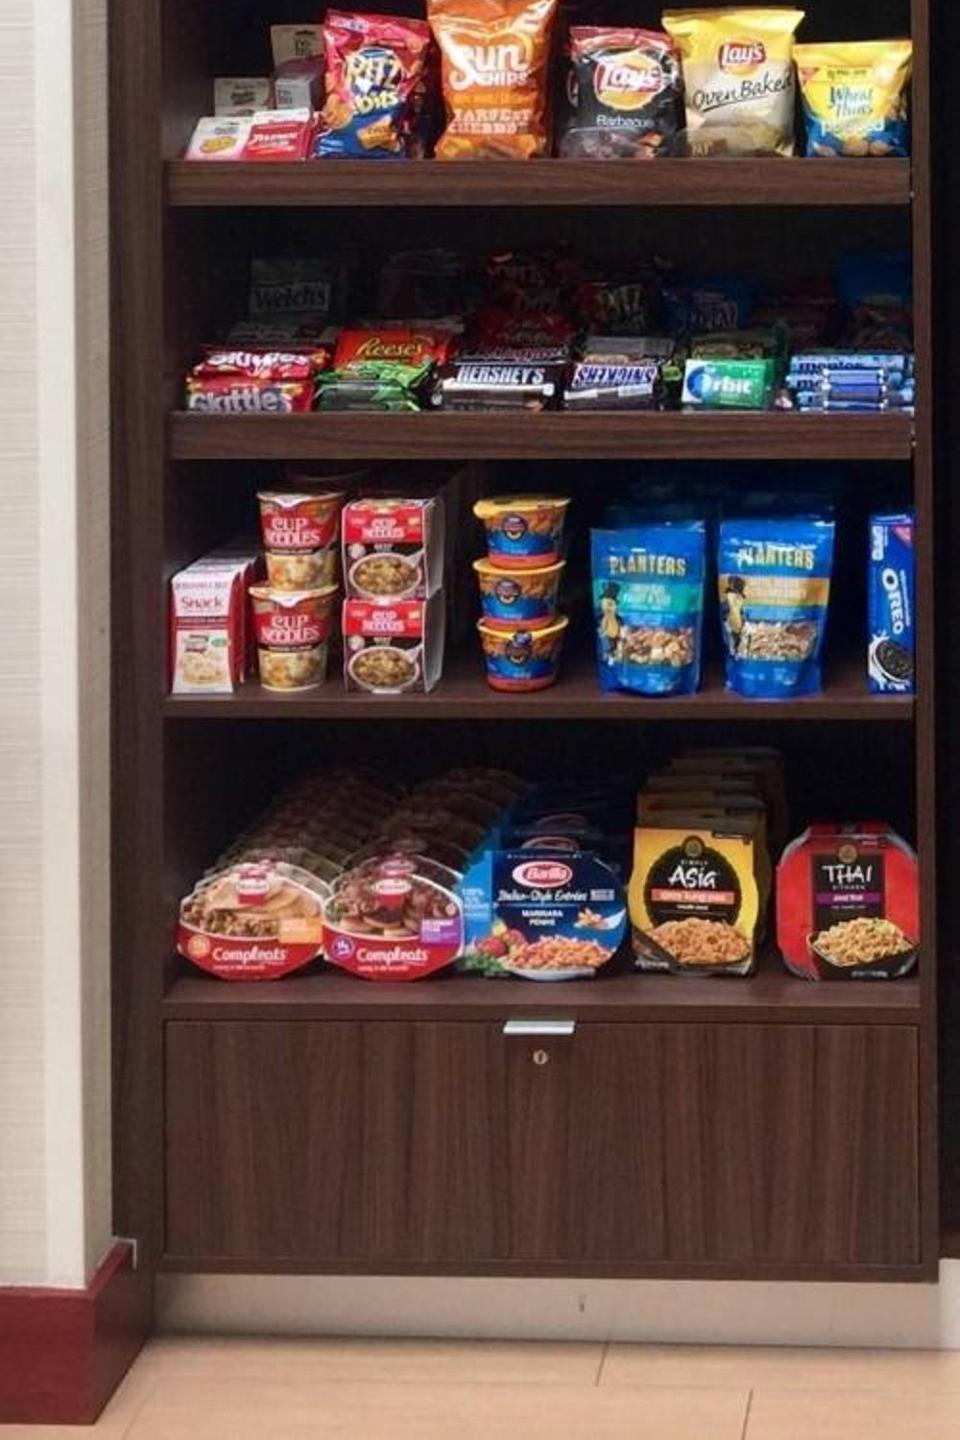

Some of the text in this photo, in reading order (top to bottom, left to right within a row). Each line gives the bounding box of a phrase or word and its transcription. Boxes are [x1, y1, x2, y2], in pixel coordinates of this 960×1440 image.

[448, 42, 532, 92] Sun
[474, 71, 531, 88] CHIPS
[692, 68, 794, 108] Oven Baked
[456, 364, 547, 384] HERSHEY'S
[699, 373, 754, 395] Orbit
[270, 516, 308, 532] CUP
[263, 529, 321, 547] NOODLES
[609, 553, 687, 577] PLANTERS
[736, 546, 815, 572] PLANTERS
[181, 595, 223, 610] Snack
[881, 567, 905, 635] OREO
[270, 614, 309, 630] CUP
[261, 627, 321, 645] NOODLES
[821, 864, 873, 885] THAI
[211, 945, 288, 965] Compleats
[355, 945, 429, 966] Compleats
